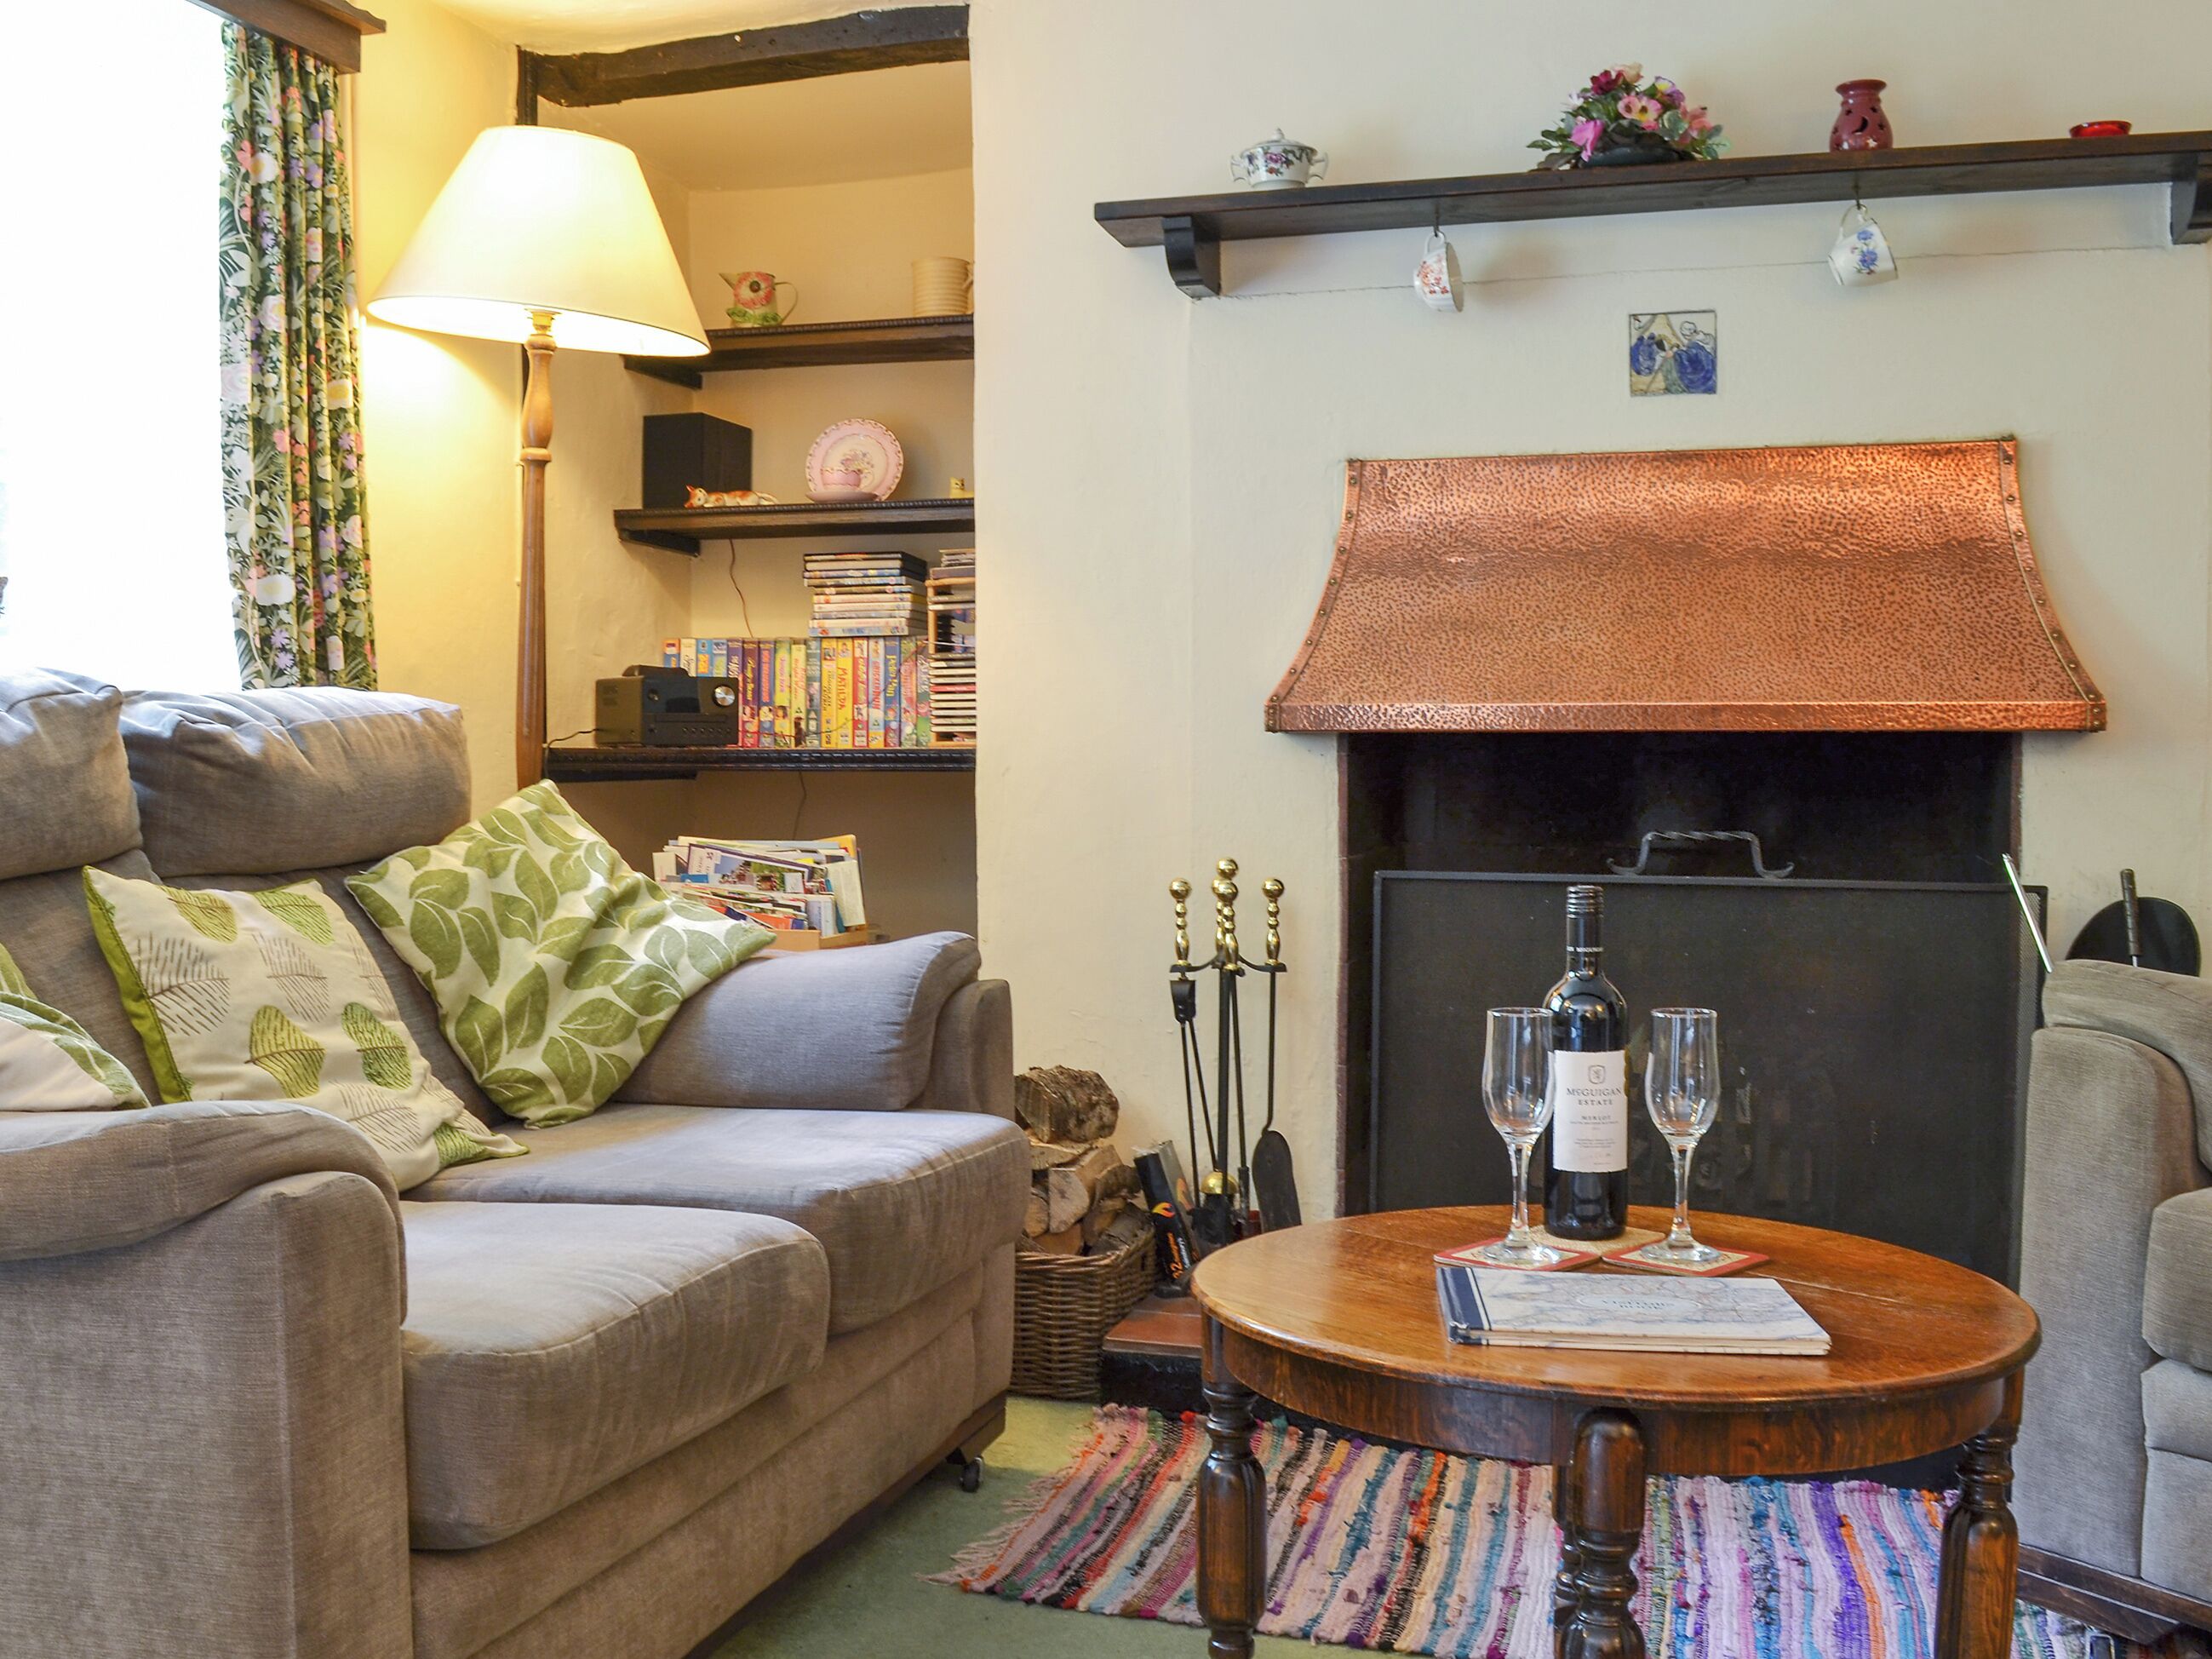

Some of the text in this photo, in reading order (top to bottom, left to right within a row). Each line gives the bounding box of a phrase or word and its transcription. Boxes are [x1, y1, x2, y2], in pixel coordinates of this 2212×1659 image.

[838, 667, 849, 710] MATILDA
[872, 660, 881, 691] CHICKEN
[886, 654, 898, 697] Peter Pan
